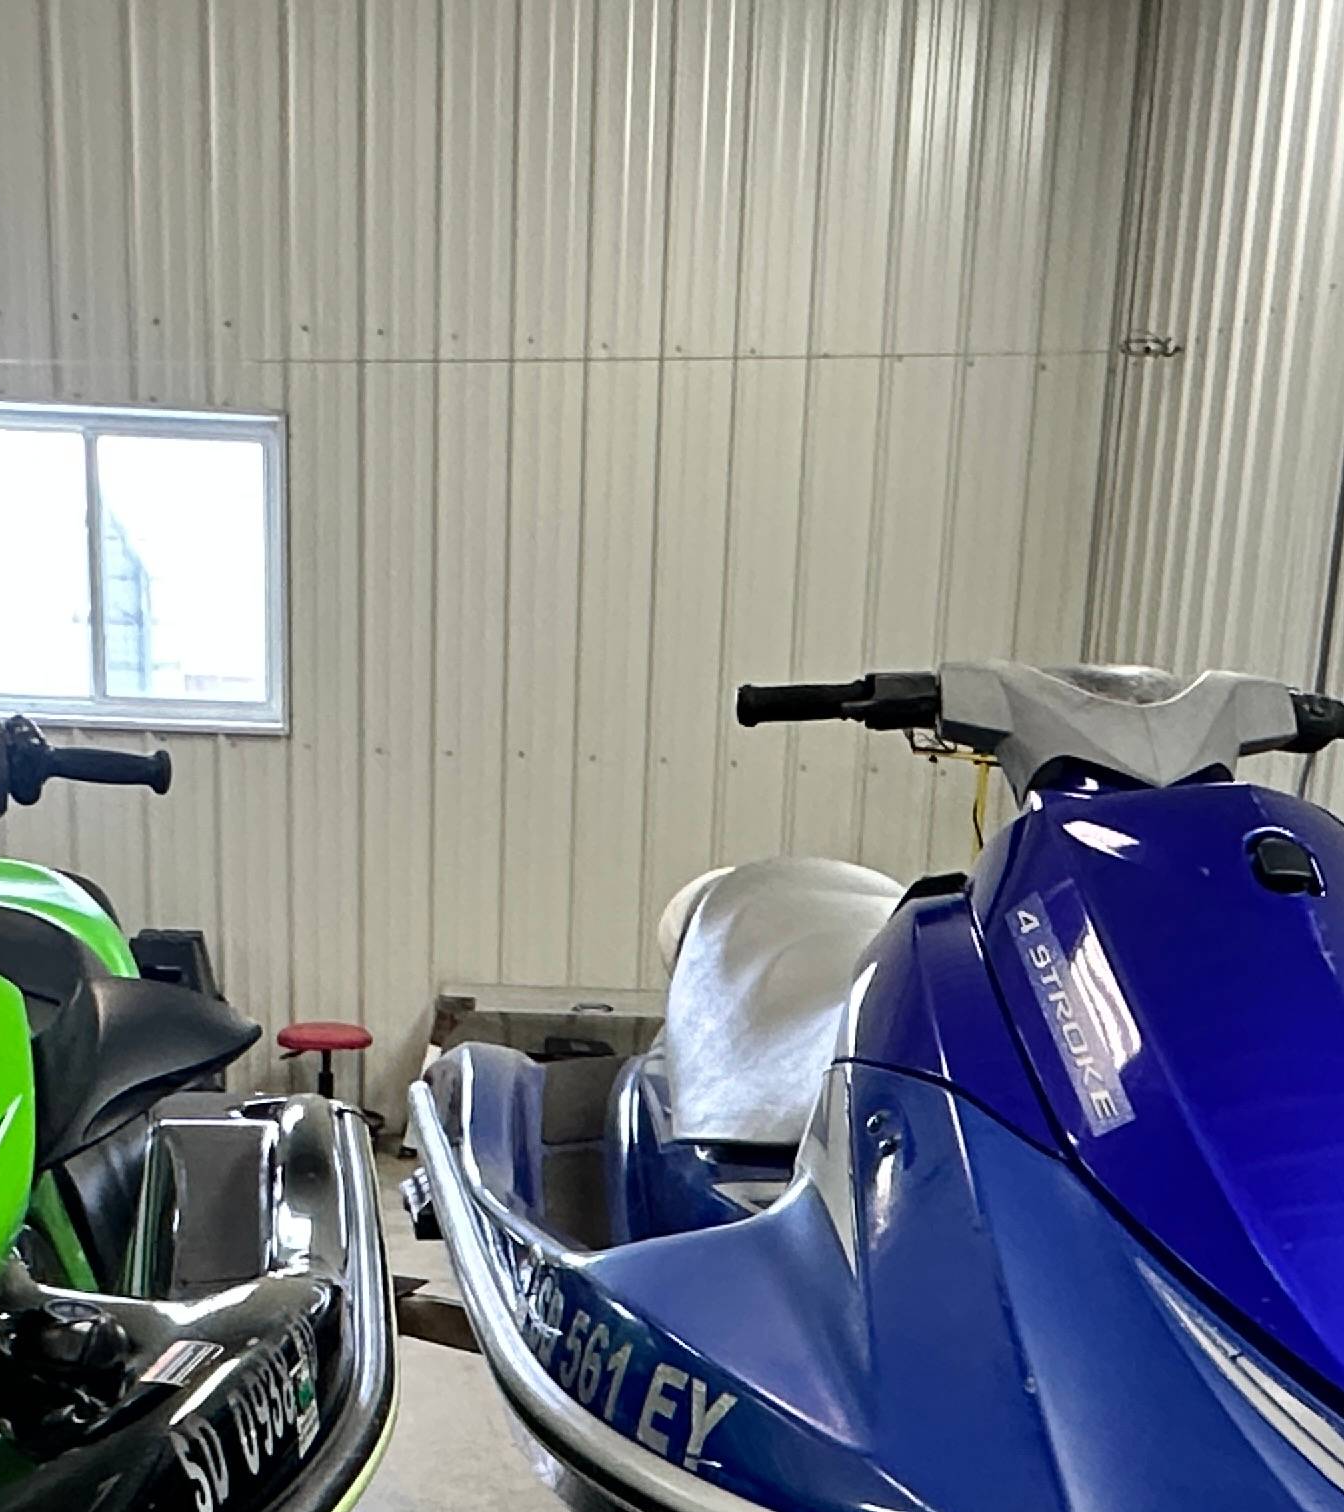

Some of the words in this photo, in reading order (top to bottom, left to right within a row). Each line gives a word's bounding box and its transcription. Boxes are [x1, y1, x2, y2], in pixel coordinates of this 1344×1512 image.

[1016, 910, 1041, 934] 4
[1028, 944, 1119, 1120] STROKE
[560, 1309, 633, 1422] 561
[636, 1362, 738, 1470] EY
